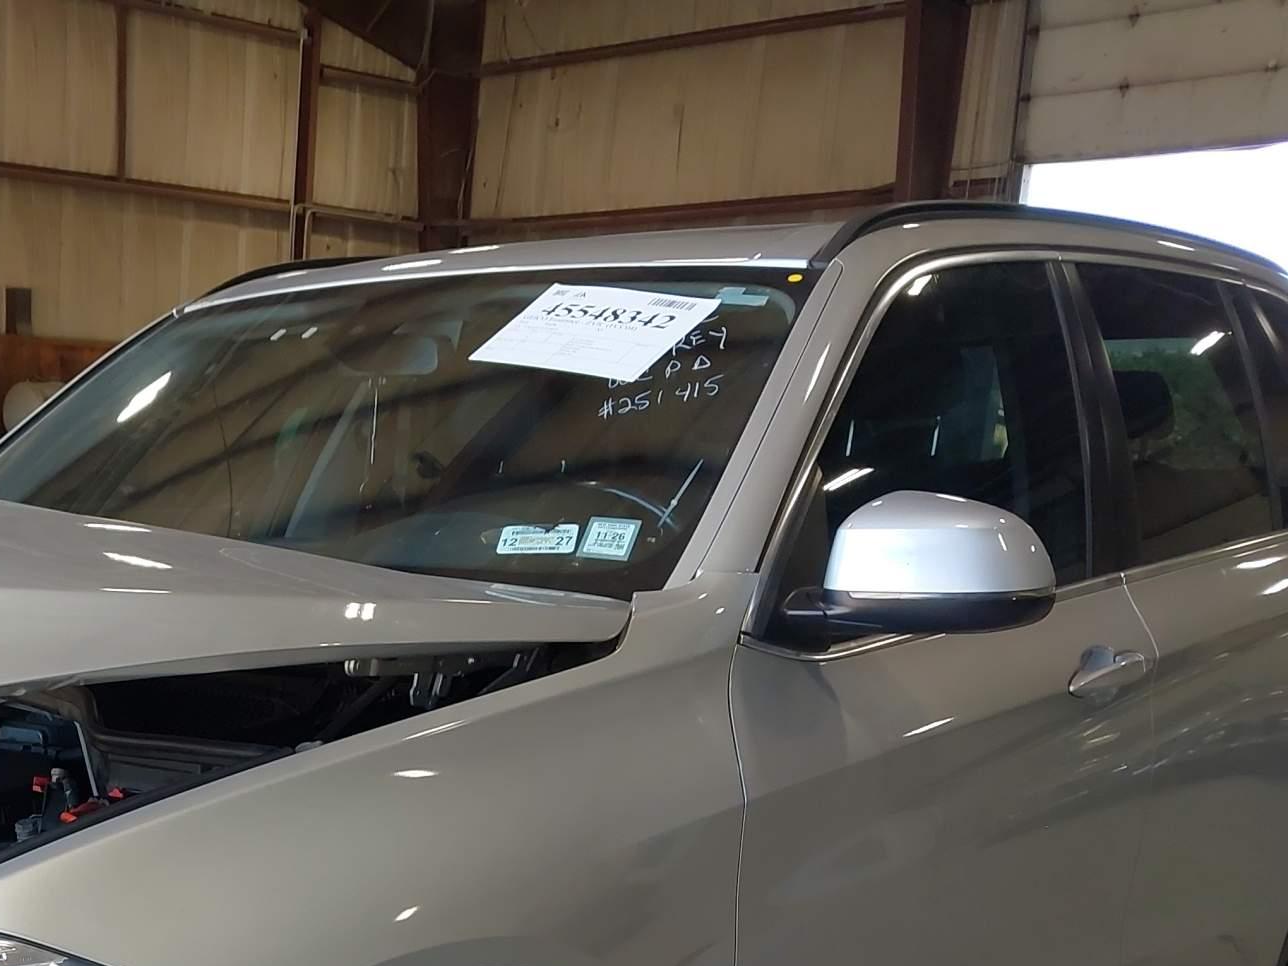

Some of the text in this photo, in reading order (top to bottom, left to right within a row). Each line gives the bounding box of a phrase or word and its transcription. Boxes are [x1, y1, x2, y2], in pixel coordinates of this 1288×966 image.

[542, 302, 677, 329] 45548342
[502, 535, 574, 547] 12 27
